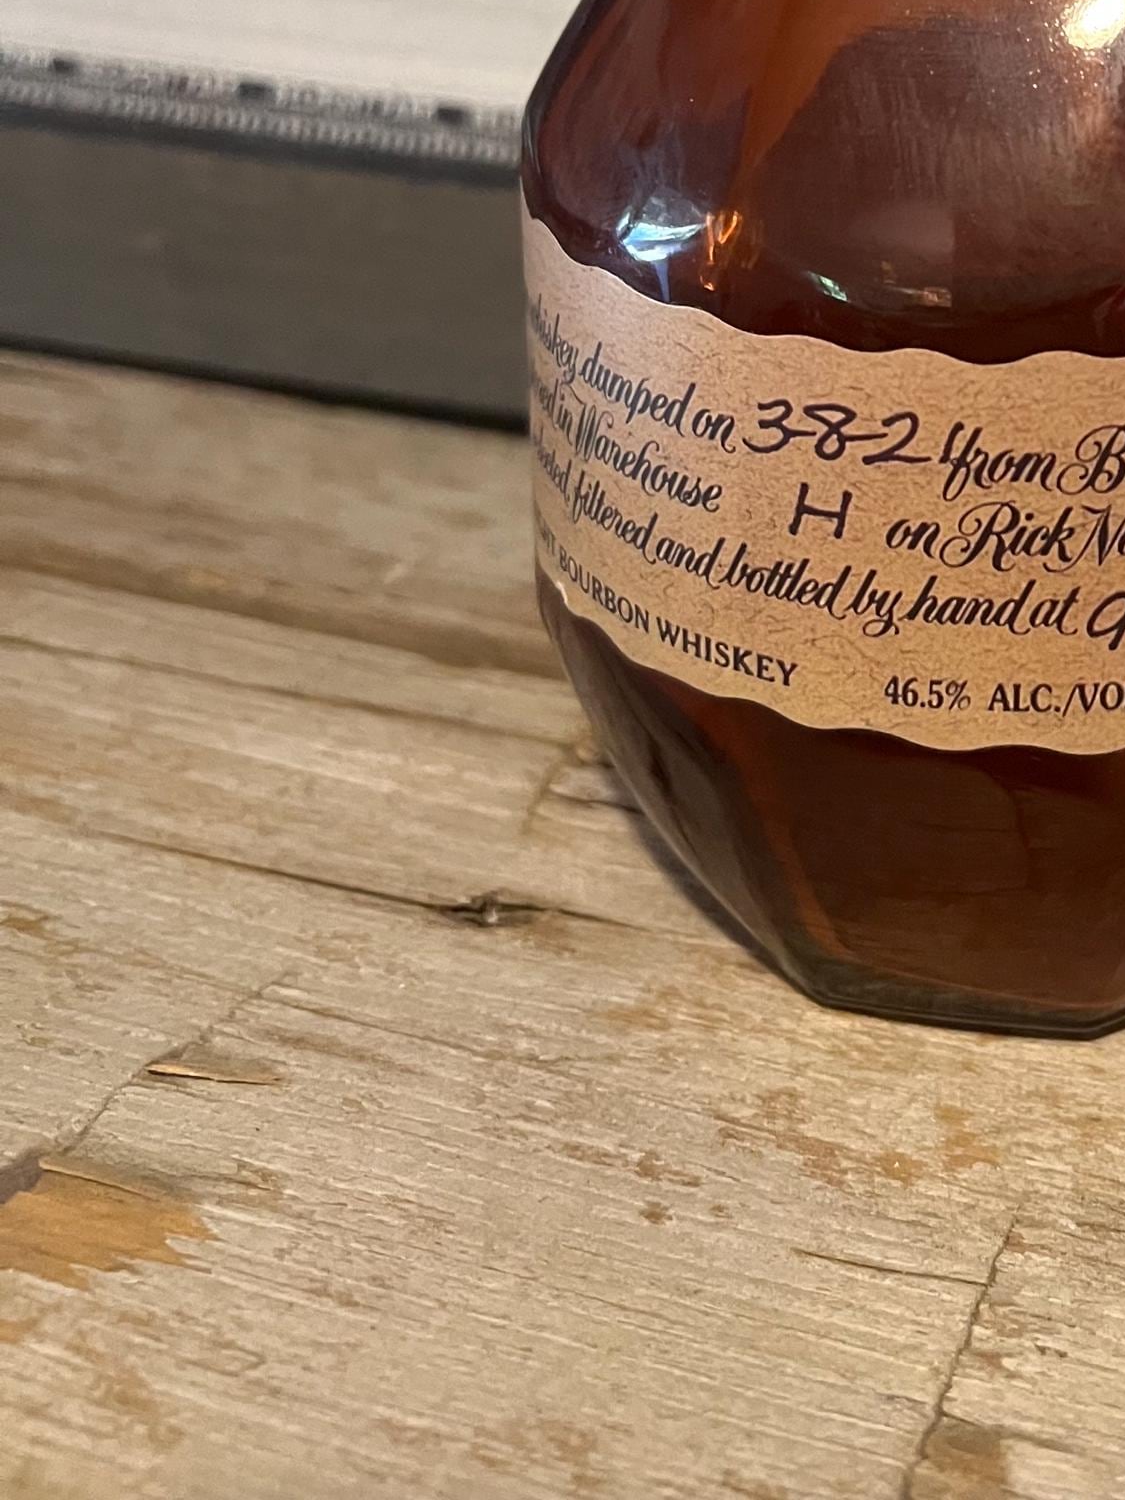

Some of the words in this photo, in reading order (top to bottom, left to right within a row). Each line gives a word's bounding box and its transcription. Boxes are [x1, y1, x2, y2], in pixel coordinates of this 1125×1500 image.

[568, 385, 723, 513] Warehouse
[788, 481, 853, 540] H
[885, 519, 943, 558] on
[939, 500, 1077, 573] Rick
[578, 341, 686, 437] dumped
[691, 408, 736, 454] on
[941, 426, 1055, 502] from
[559, 545, 650, 634] BOURBON
[655, 617, 799, 688] WHISKEY
[573, 469, 656, 566] filtered
[655, 537, 720, 590] and
[719, 542, 852, 619] bottled
[847, 569, 904, 638] by
[897, 575, 1036, 636] hand
[1028, 585, 1081, 636] at
[884, 675, 972, 712] 46.5%
